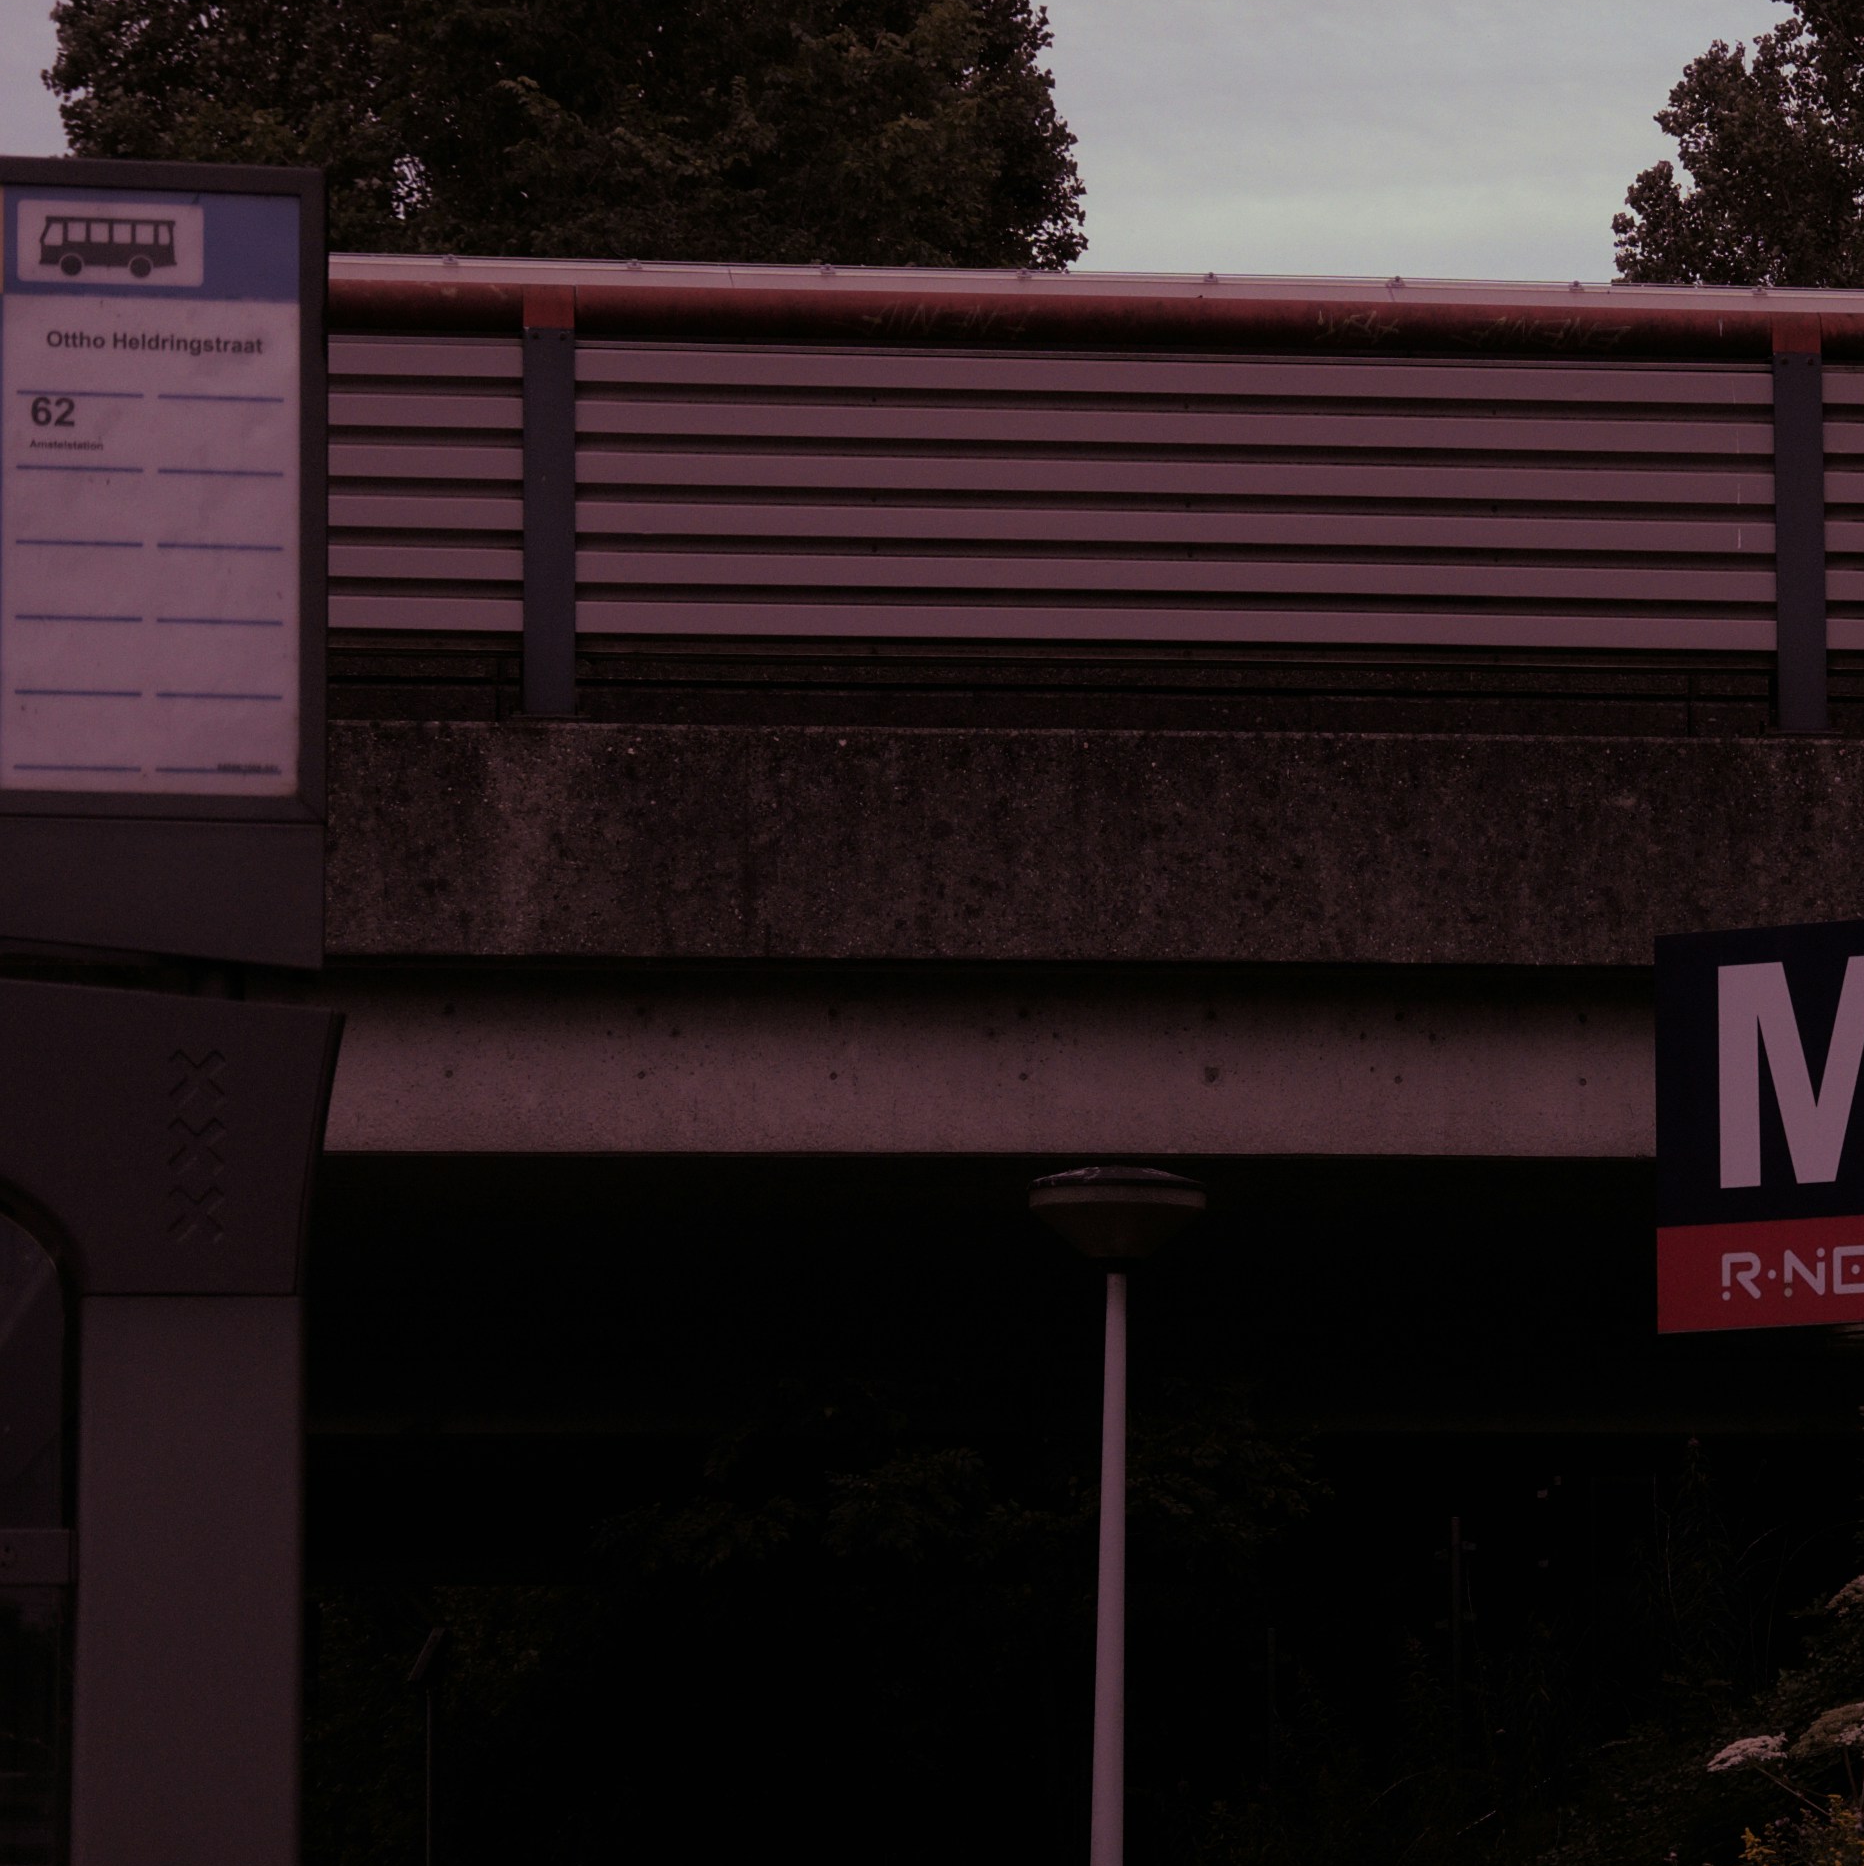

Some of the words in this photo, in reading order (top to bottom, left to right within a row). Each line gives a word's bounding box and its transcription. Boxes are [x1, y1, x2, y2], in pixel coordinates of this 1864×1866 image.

[47, 331, 105, 349] Ottho
[113, 333, 262, 355] Heldringstraat
[31, 396, 75, 427] 62
[29, 439, 103, 451] Amstelstation
